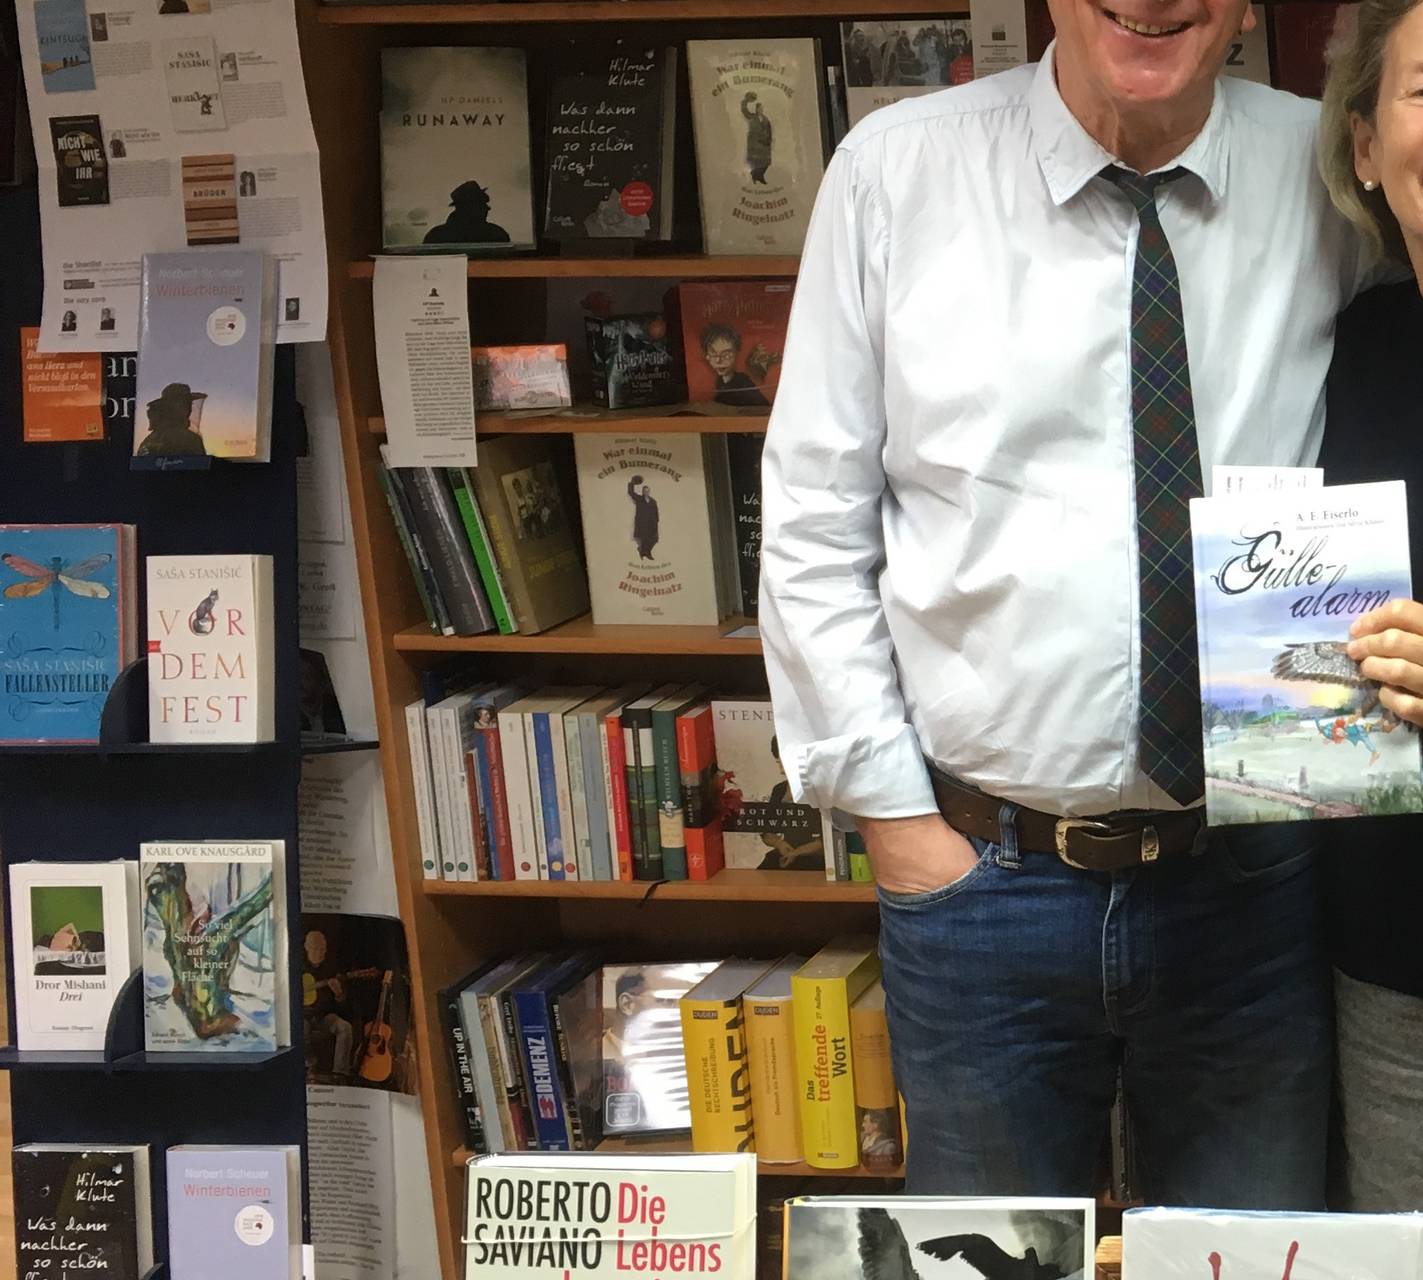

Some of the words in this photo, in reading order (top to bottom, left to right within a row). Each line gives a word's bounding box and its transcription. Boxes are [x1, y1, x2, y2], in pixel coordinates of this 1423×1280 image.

[609, 58, 655, 74] Hilmar
[608, 74, 646, 87] Klute
[560, 102, 588, 117] Was
[596, 102, 636, 116] dann
[402, 113, 506, 127] RUNAWAY
[552, 123, 617, 135] nachher
[563, 142, 580, 152] so
[589, 138, 634, 152] schön
[628, 446, 672, 462] einmal
[619, 459, 683, 482] Bumerang
[1211, 521, 1338, 596] Gülle-
[156, 565, 186, 579] SAŠA
[626, 571, 676, 584] Joachim
[618, 583, 683, 598] Ringelnatz
[1290, 565, 1392, 619] alarm
[158, 608, 246, 637] VOR
[160, 651, 247, 681] DEM
[5, 674, 109, 693] FALLENSTELLER
[161, 695, 248, 724] FEST
[738, 808, 767, 818] ROT
[776, 807, 806, 817] UND
[737, 817, 809, 828] SCHWARZ
[145, 847, 174, 857] KARL
[176, 847, 197, 857] OVE
[200, 846, 267, 857] KNAUSGÅRD
[198, 920, 212, 929] So
[214, 919, 233, 930] viel
[174, 932, 228, 943] Sehnsucht
[193, 960, 229, 970] kleiner
[35, 980, 61, 991] Dror
[64, 979, 106, 991] Mishani
[59, 991, 83, 1002] Drei
[453, 1027, 464, 1042] UP
[455, 1043, 467, 1054] IN
[457, 1054, 470, 1075] THE
[528, 1037, 555, 1095] DEMENZ
[806, 1080, 816, 1101] Das
[811, 1025, 830, 1102] treffende
[831, 1037, 847, 1077] Wort
[708, 1037, 721, 1114] RECHTSCHREIBUNG
[460, 1076, 472, 1094] AIR
[76, 1172, 123, 1188] Hilmar
[184, 1167, 223, 1179] Norbert
[226, 1167, 269, 1180] Scheuer
[76, 1188, 115, 1203] Klute
[184, 1183, 272, 1198] Winterbienen
[475, 1177, 611, 1223] ROBERTO
[617, 1181, 666, 1226] Die
[27, 1216, 56, 1232] Was
[65, 1217, 109, 1232] dann
[21, 1238, 88, 1252] nachher
[474, 1224, 601, 1270] SAVIANO
[617, 1224, 721, 1272] Lebens
[33, 1257, 50, 1268] so
[61, 1253, 108, 1269] schön
